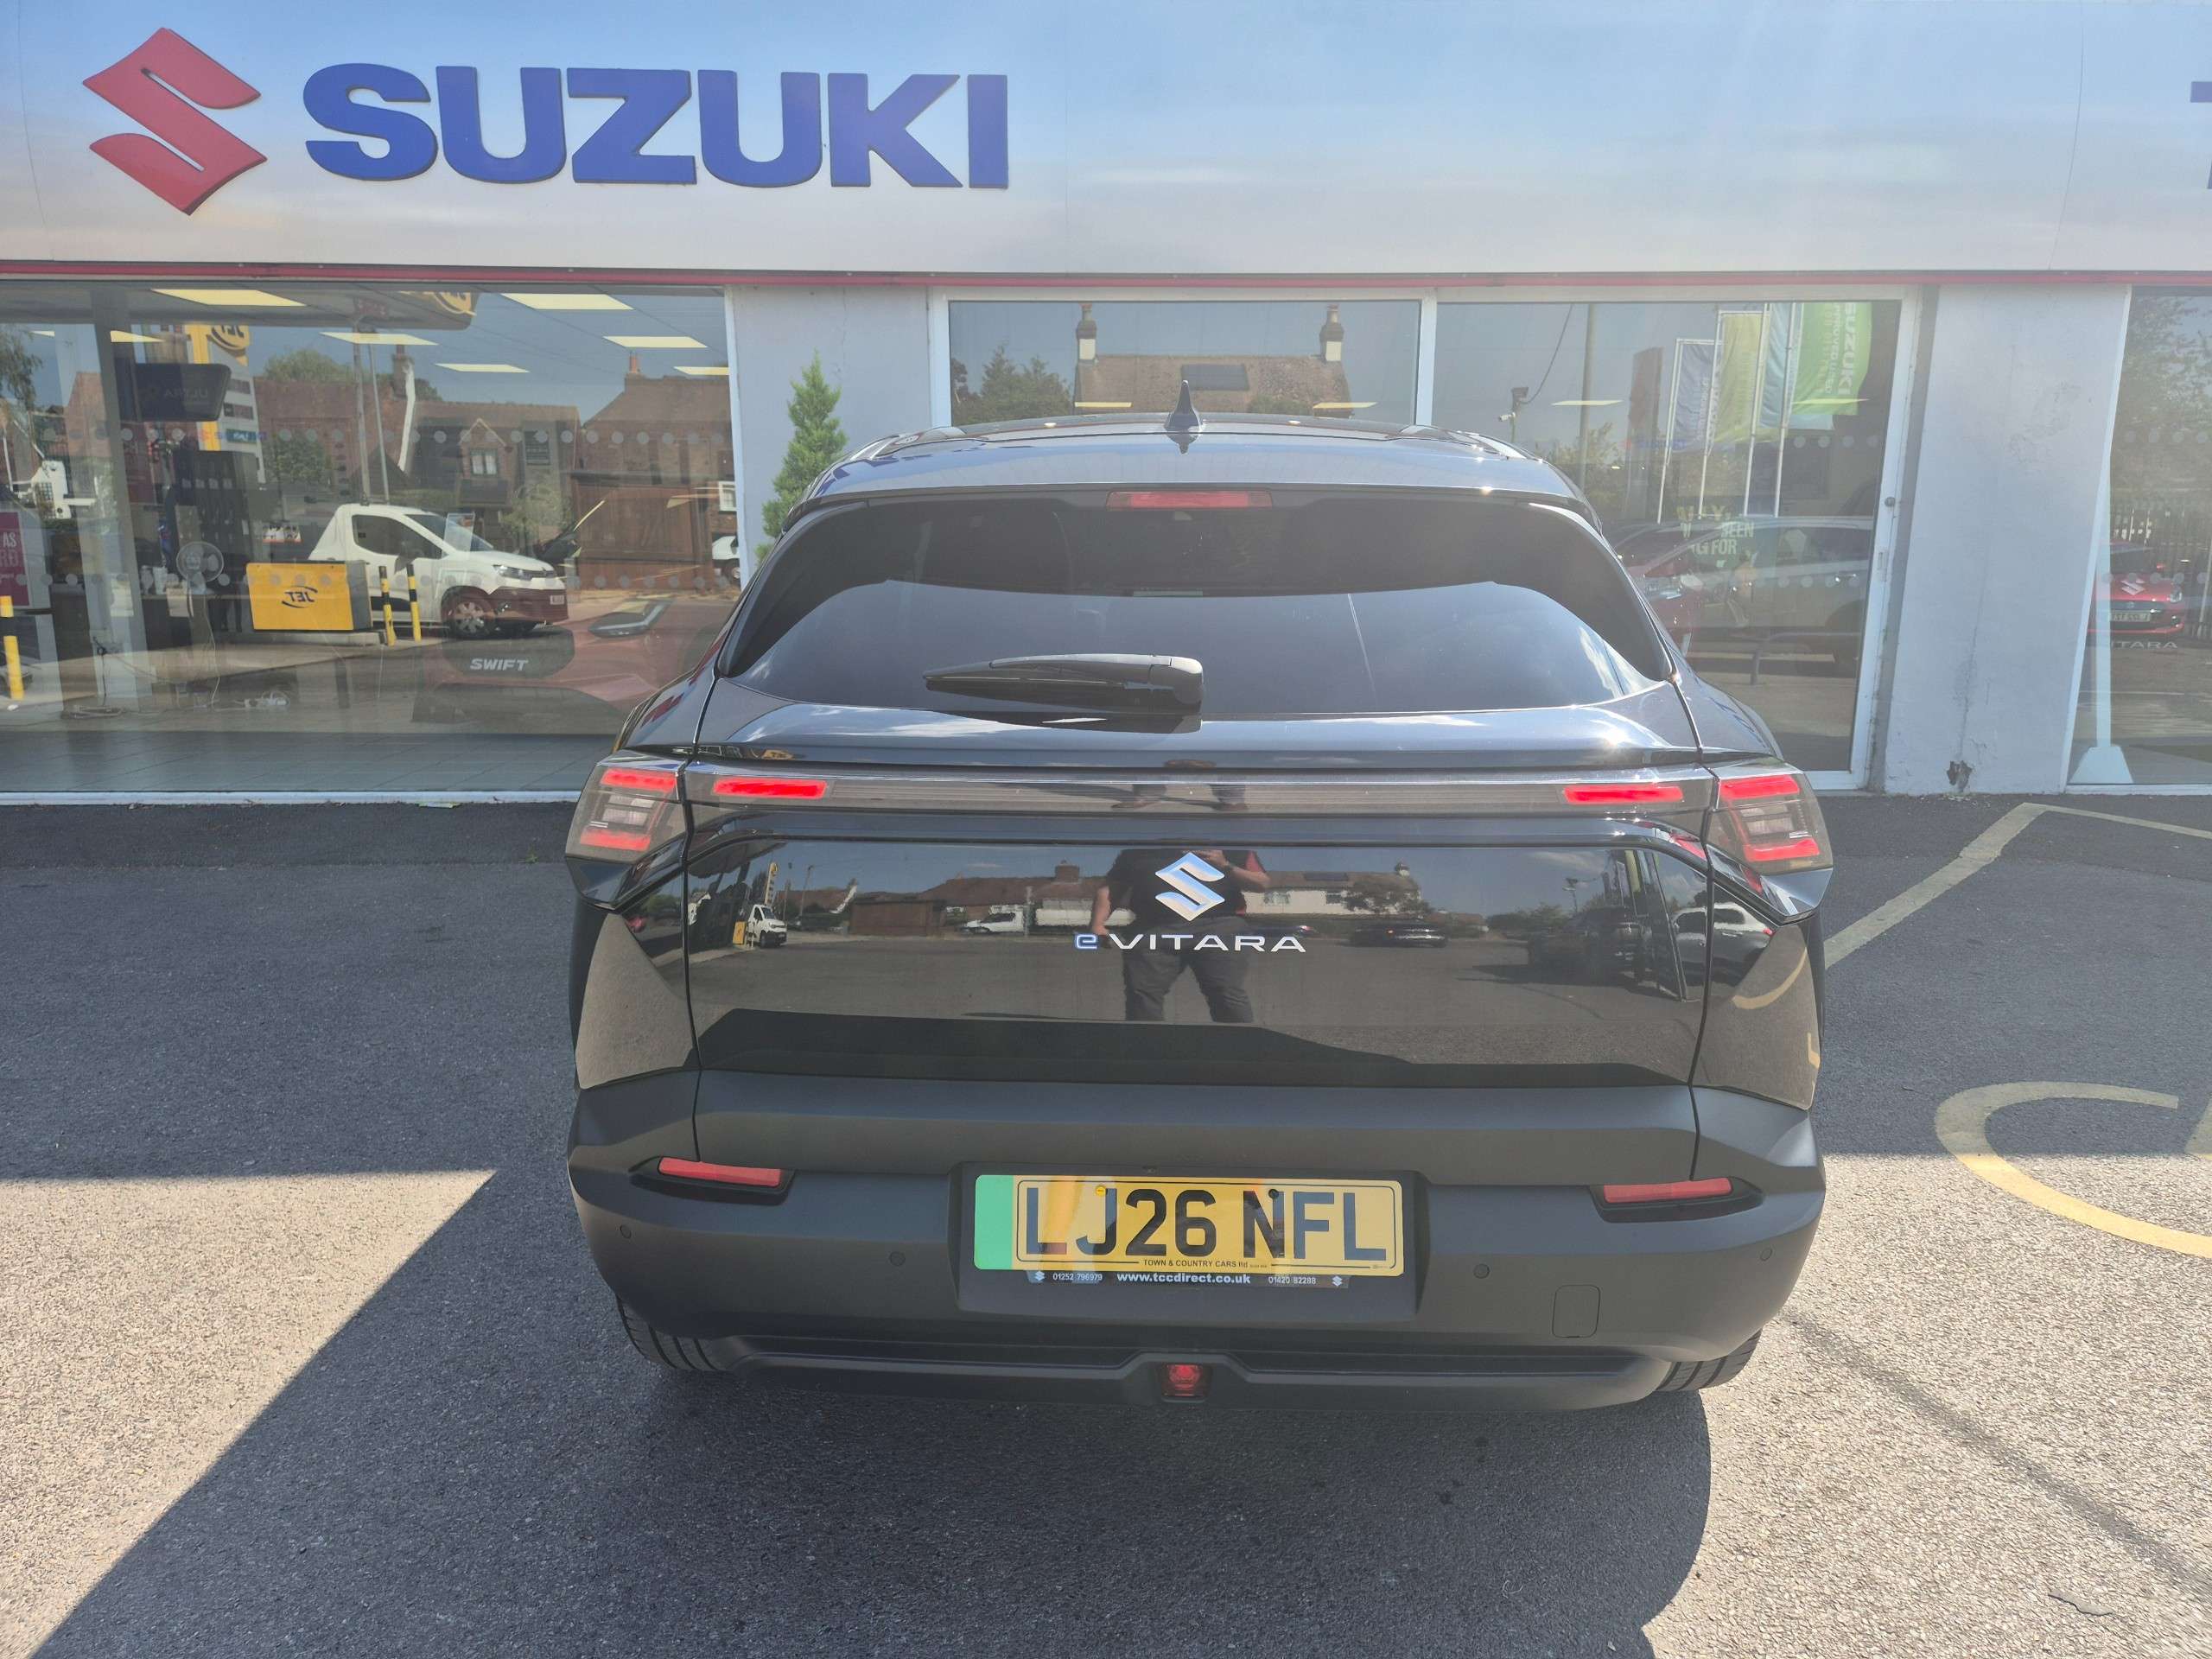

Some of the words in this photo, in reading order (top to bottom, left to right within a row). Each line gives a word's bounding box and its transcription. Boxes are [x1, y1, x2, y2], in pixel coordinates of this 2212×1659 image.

[302, 61, 1009, 190] SUZUKI
[3, 531, 17, 547] AS
[1711, 539, 1737, 555] FOR
[469, 658, 529, 671] SWIFT
[1109, 933, 1306, 953] VITARA
[1026, 1186, 1217, 1257] LJ26
[1243, 1190, 1388, 1261] NFL
[1215, 1260, 1237, 1268] CARS
[1052, 1273, 1074, 1281] 01252
[1116, 1273, 1251, 1285] www.tccdirect.co.uk
